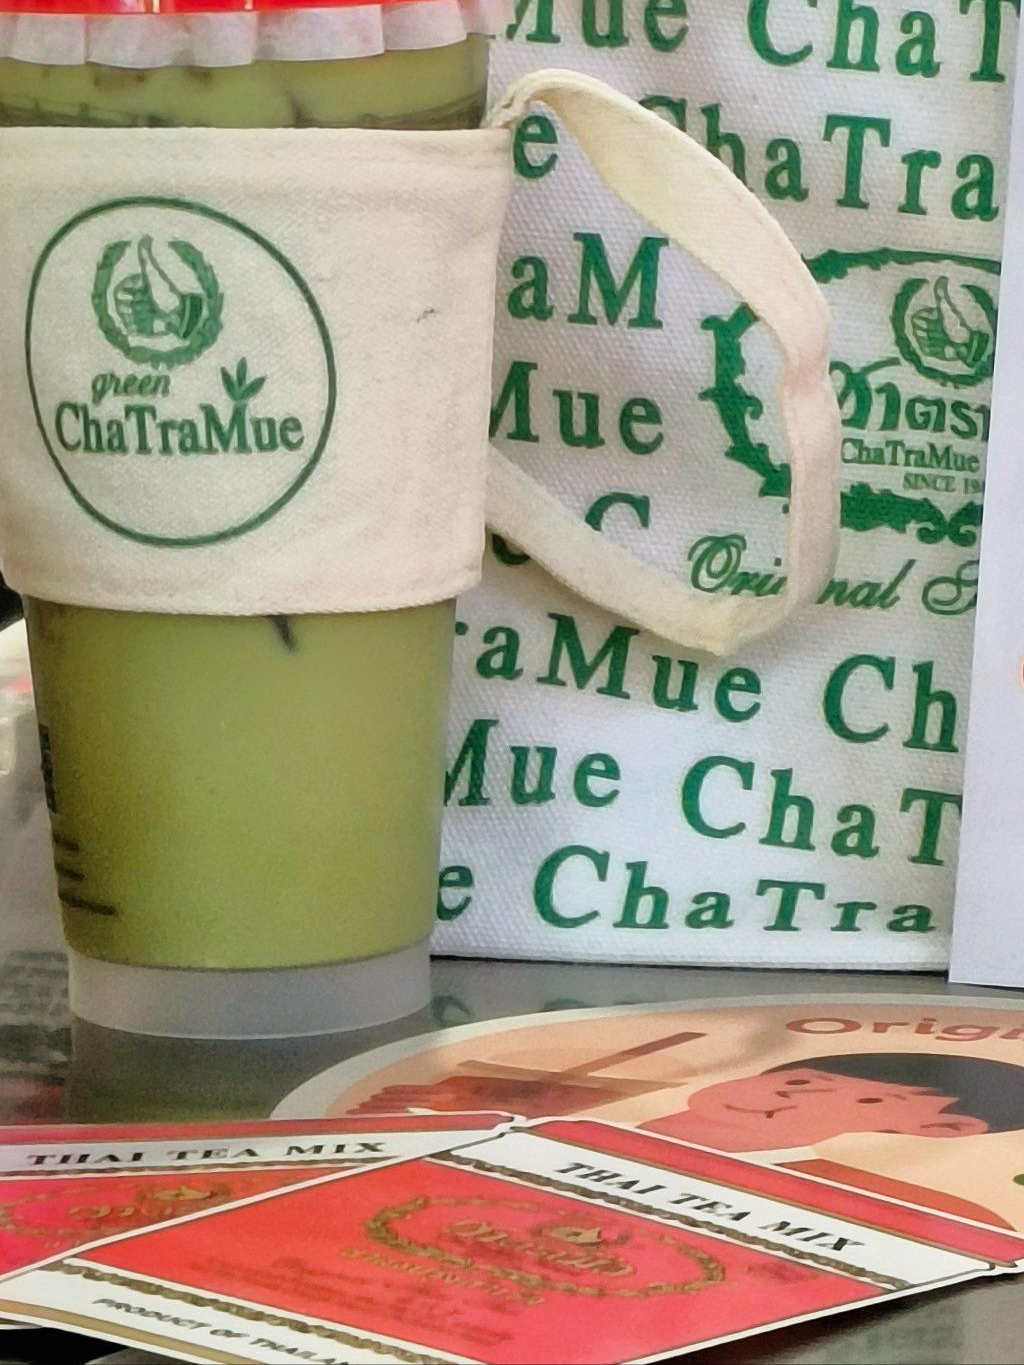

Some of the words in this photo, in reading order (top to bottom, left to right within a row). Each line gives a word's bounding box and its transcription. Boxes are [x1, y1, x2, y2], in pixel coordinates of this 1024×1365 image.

[513, 115, 558, 179] e
[507, 232, 669, 330] aM
[91, 372, 170, 403] green
[55, 401, 304, 455] ChaTraMue
[841, 437, 981, 474] ChaTraMue
[454, 612, 762, 723] aMue
[822, 653, 960, 753] Ch
[680, 755, 964, 867] ChaT
[532, 844, 937, 933] ChaTra
[27, 1153, 146, 1166] THAI
[167, 1148, 259, 1161] TEA
[285, 1142, 387, 1156] MIX
[553, 1162, 667, 1194] THAI
[668, 1193, 751, 1221] TEA
[757, 1220, 866, 1252] MIX
[210, 1329, 250, 1338] OF
